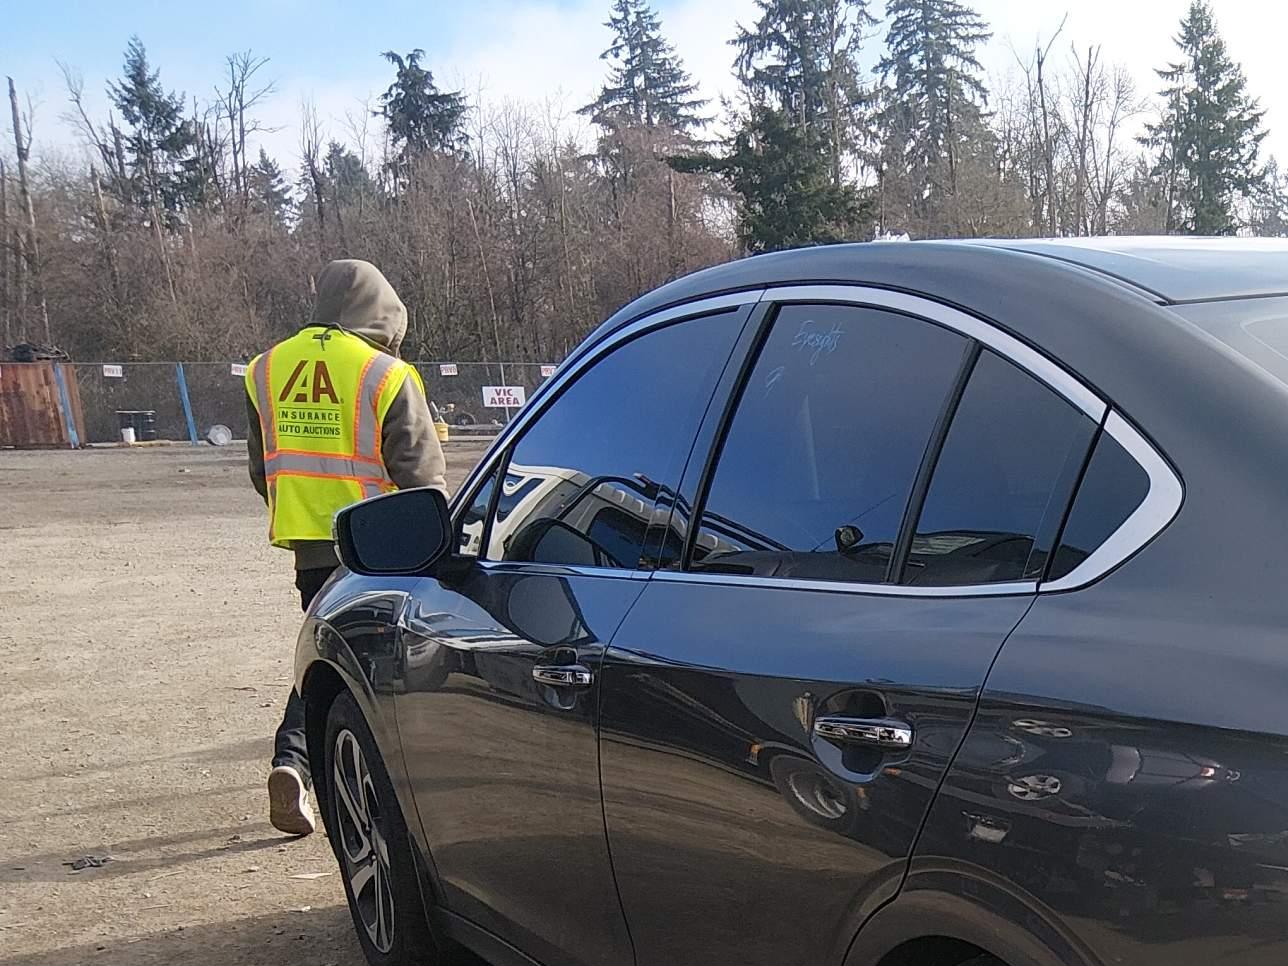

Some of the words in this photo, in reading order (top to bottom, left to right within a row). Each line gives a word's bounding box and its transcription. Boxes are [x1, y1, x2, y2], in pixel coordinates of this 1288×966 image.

[494, 388, 513, 397] VIC
[490, 397, 520, 405] AREA
[278, 410, 341, 422] INSURANCE
[302, 425, 341, 436] AUCTIONS
